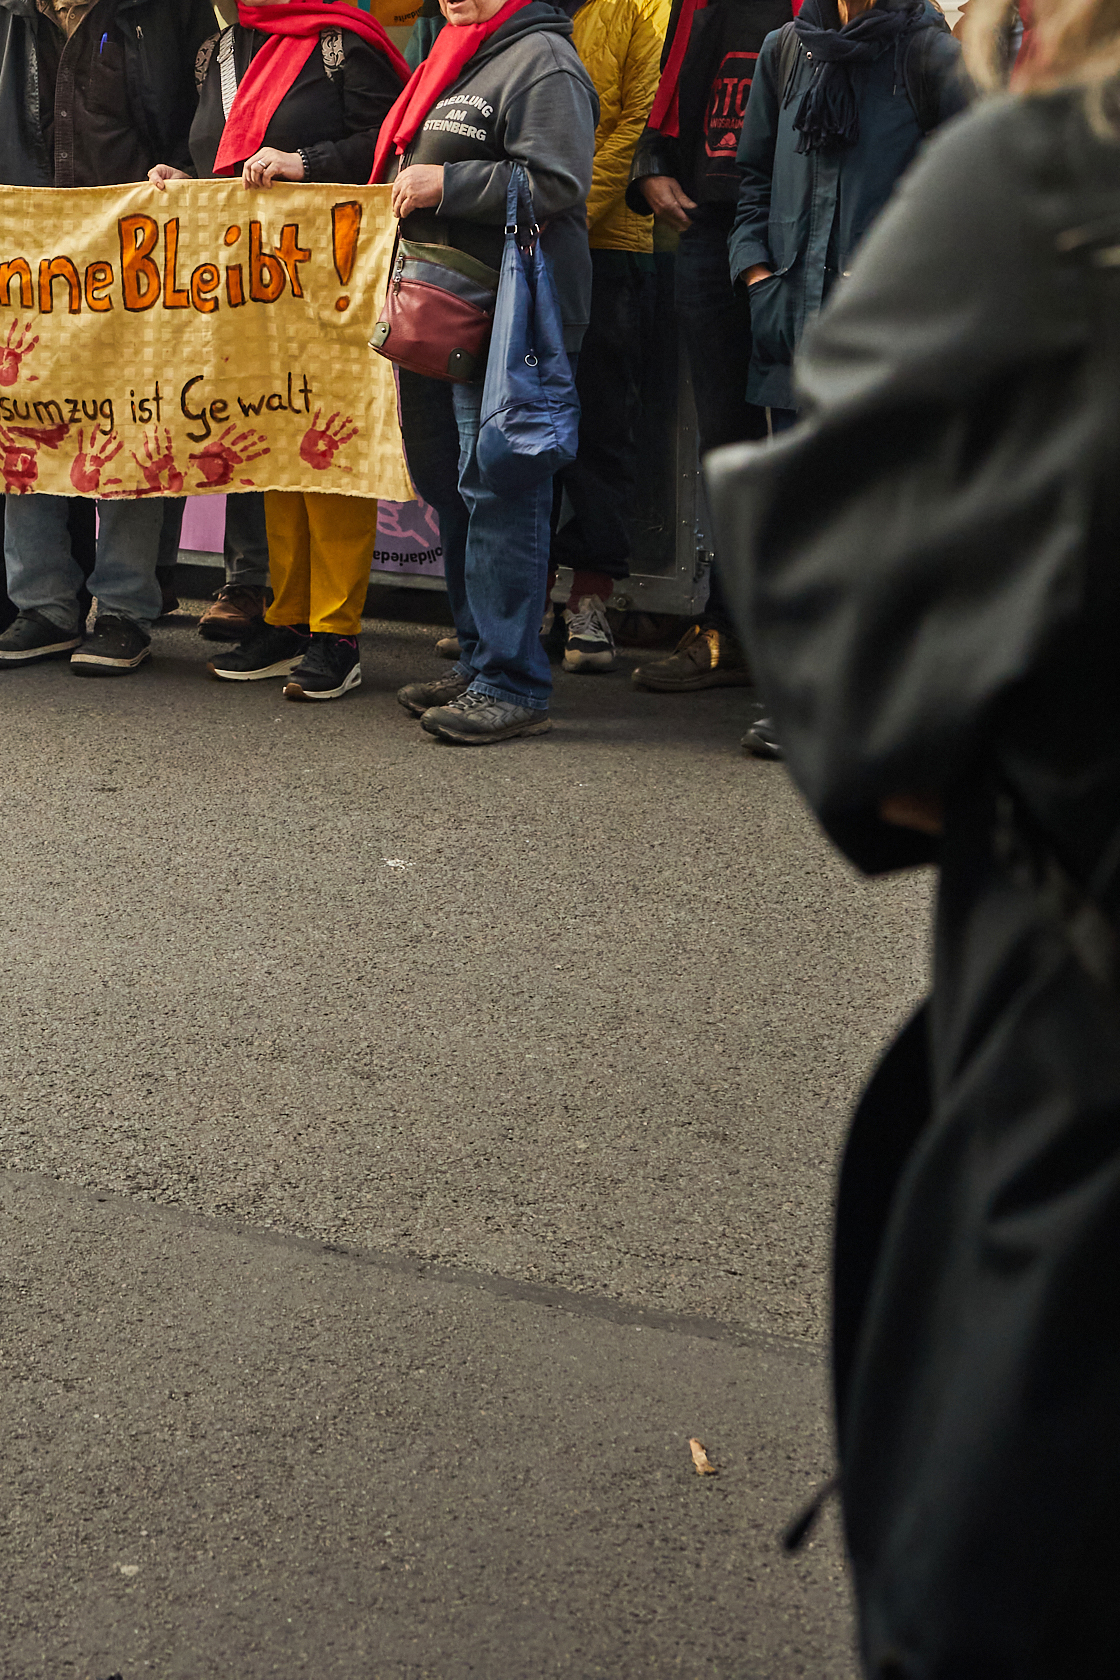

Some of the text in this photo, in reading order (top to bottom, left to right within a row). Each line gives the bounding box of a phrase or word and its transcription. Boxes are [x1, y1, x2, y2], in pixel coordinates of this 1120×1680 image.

[436, 95, 494, 118] SIEDLUNG
[712, 78, 753, 117] STO
[445, 109, 468, 121] AM
[423, 119, 487, 141] STEINBERG
[130, 381, 163, 424] ist
